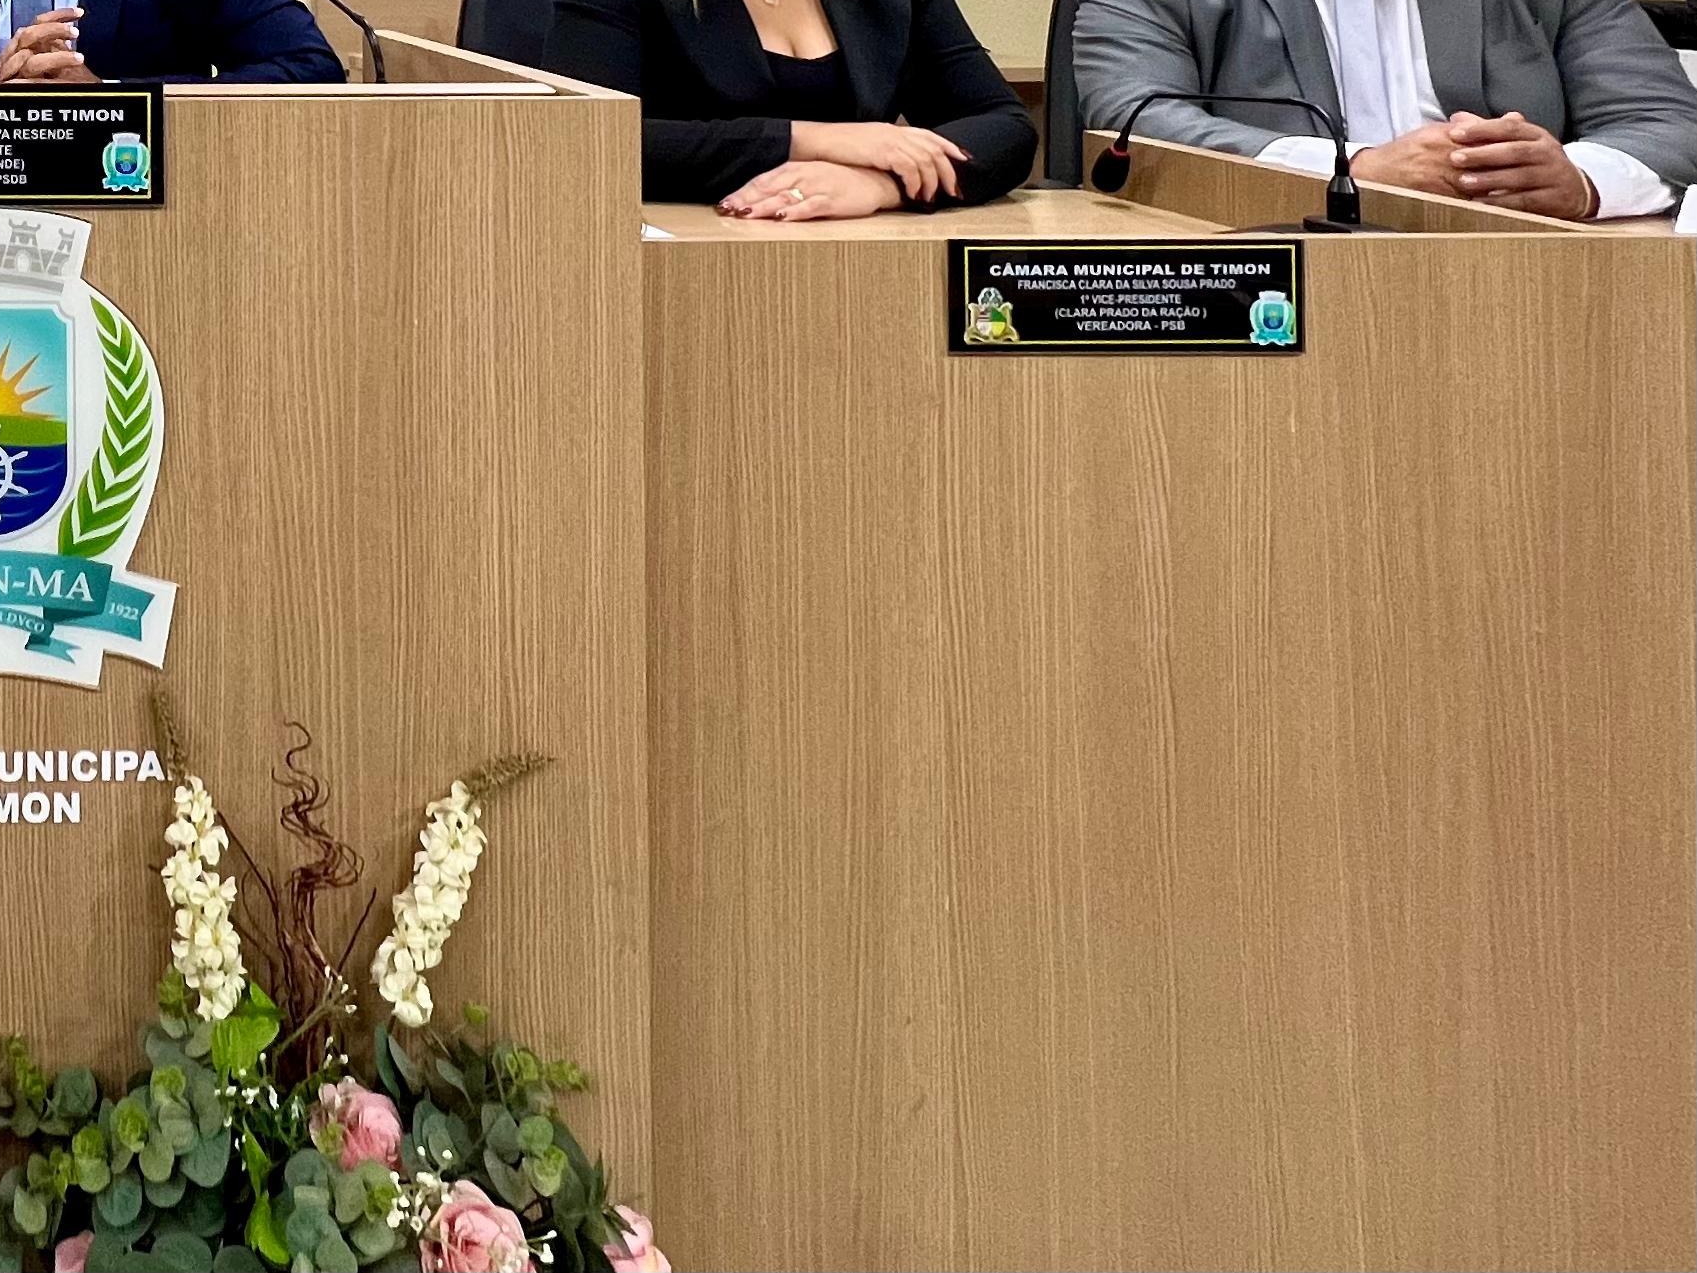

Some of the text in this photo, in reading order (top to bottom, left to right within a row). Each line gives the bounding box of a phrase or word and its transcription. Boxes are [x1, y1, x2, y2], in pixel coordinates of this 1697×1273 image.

[27, 109, 54, 122] DE
[59, 109, 124, 122] TIMON
[12, 128, 74, 140] RESENDE
[989, 263, 1271, 276] CÂMARA MUNICIPAL DE TIMON
[1017, 279, 1237, 290] FRANCISCA CLARA DA SILVA SOUSA PRADO
[1091, 293, 1182, 305] VICE-PRESIDENTE
[1054, 307, 1097, 319] (CLARA
[1099, 307, 1139, 318] PRADO
[1141, 308, 1158, 318] DA
[1076, 320, 1152, 332] VEREADORA
[1161, 320, 1186, 331] PSB
[108, 602, 139, 621] 1922
[6, 611, 45, 633] DVCO
